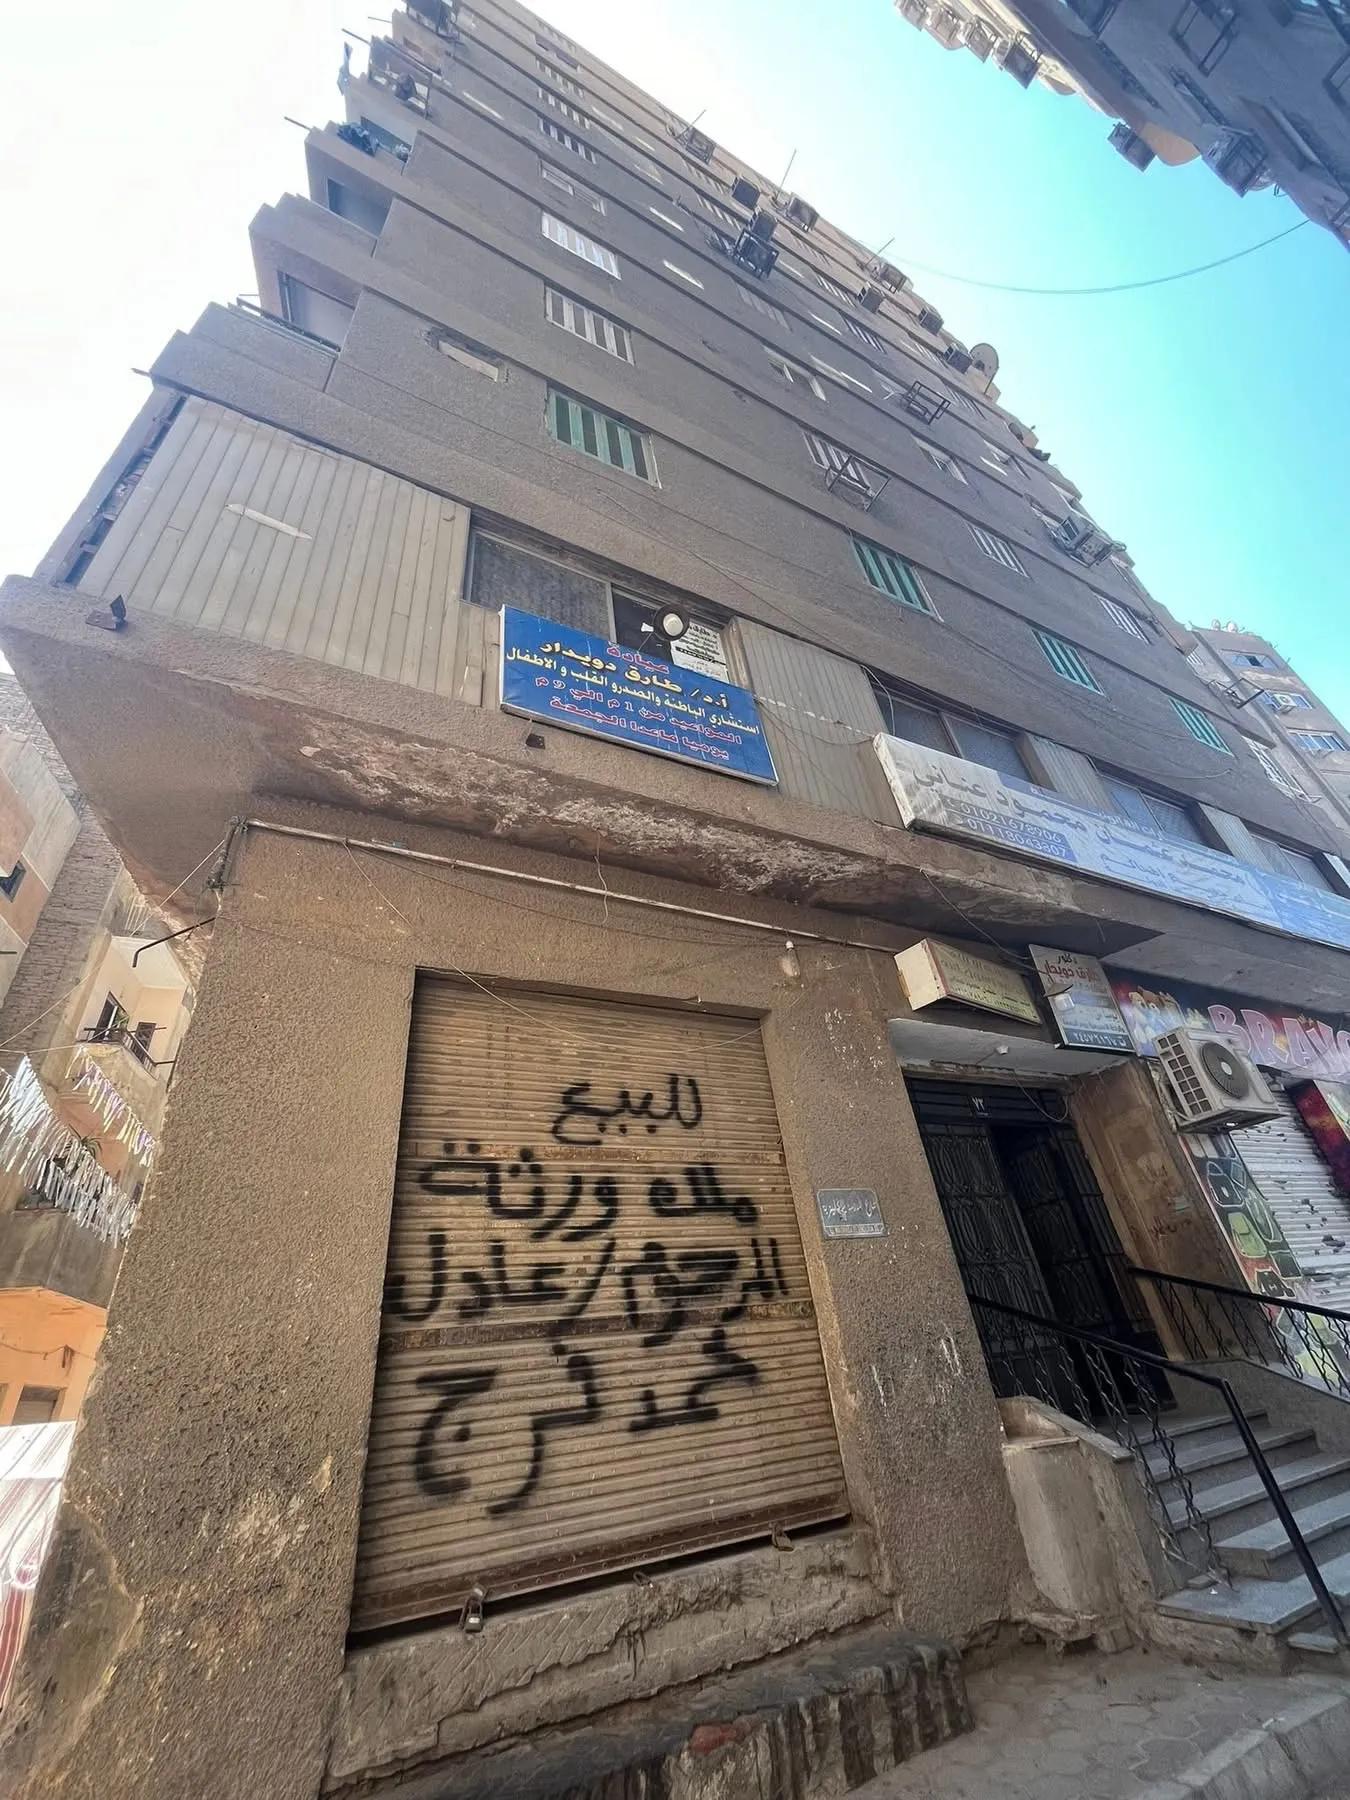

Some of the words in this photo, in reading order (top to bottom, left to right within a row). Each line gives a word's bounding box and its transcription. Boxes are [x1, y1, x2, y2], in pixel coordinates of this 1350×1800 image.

[606, 640, 669, 674] عيادة
[570, 668, 608, 687] القلب
[624, 664, 682, 693] طارق
[550, 695, 627, 729] الجمعة
[638, 706, 666, 722] من
[664, 693, 706, 719] الباطنة
[669, 717, 742, 745] المواعيد
[709, 711, 760, 735] استشاري
[682, 736, 730, 761] يوميا
[995, 789, 1088, 834] محمود
[551, 1074, 702, 1146] للبيع
[416, 1138, 620, 1242] ورثة
[383, 1228, 567, 1323] عادل
[622, 1237, 790, 1348] المرحوم
